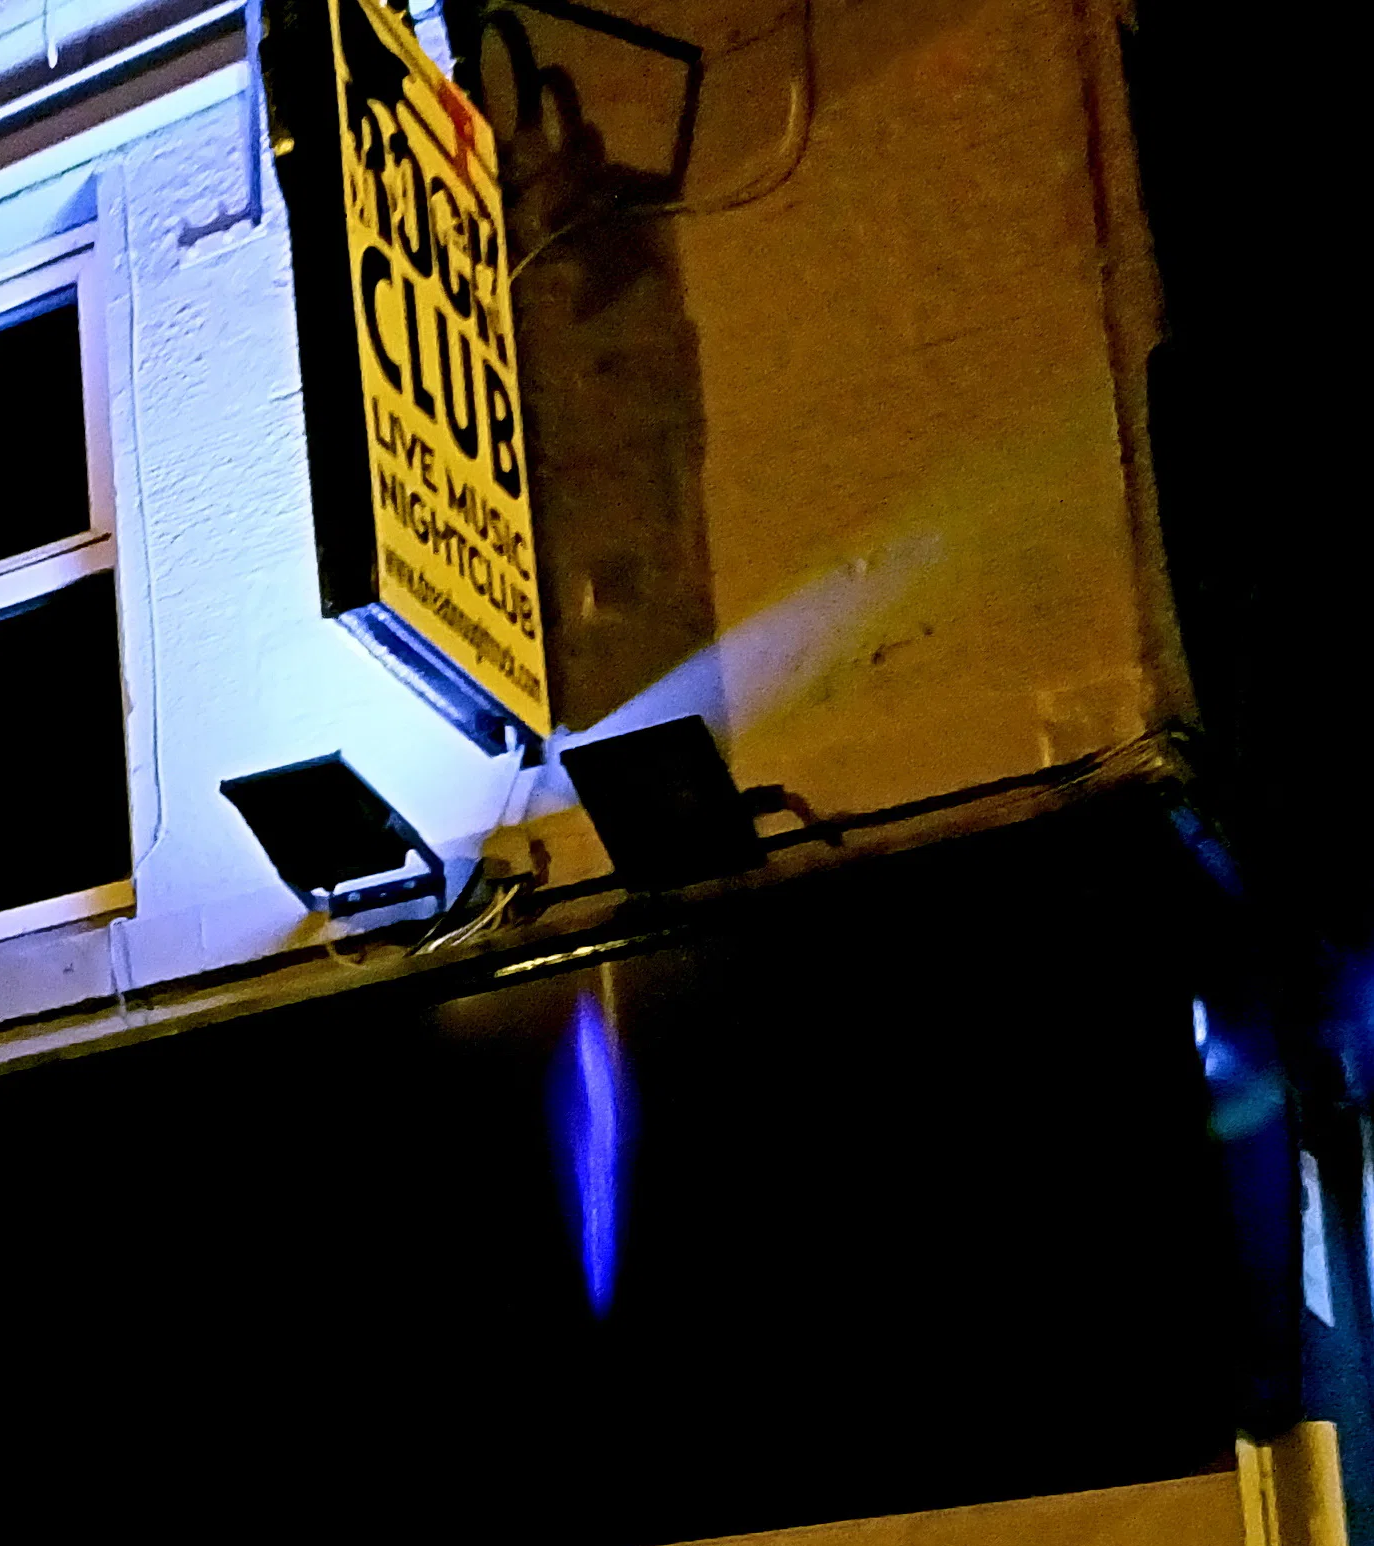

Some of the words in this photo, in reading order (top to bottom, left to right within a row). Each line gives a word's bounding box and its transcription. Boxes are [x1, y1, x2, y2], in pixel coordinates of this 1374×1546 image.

[360, 246, 522, 500] CLUB
[372, 396, 439, 495] LIVE
[444, 467, 531, 581] MUSIC
[378, 463, 536, 640] NIGHTCLUB
